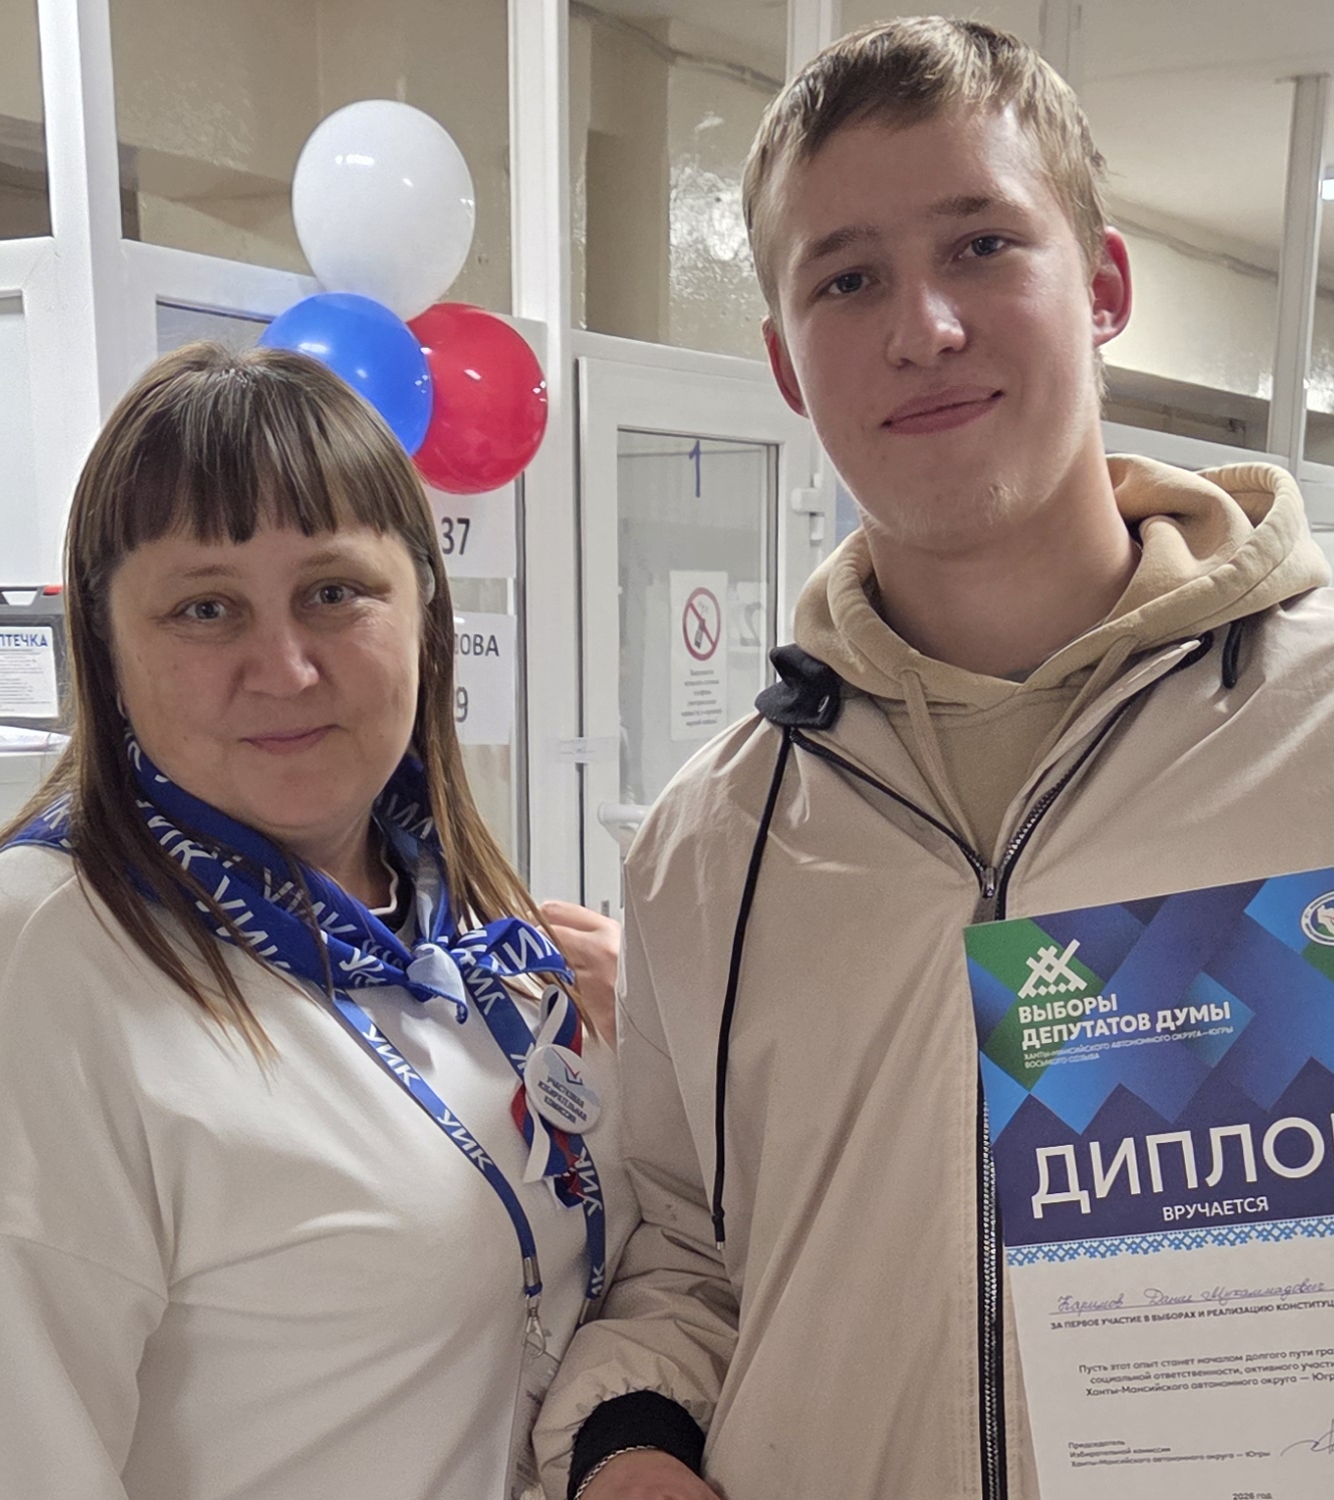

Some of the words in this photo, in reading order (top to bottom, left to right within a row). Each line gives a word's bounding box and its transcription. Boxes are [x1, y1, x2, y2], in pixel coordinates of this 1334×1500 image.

[1018, 993, 1117, 1024] ВЫБОРЫ
[1021, 1013, 1151, 1051] ДЕПУТАТОВ
[1155, 1001, 1232, 1033] ДУМЫ
[363, 1023, 421, 1087] УИК
[437, 1109, 493, 1170] УИК
[1162, 1196, 1269, 1222] ВРУЧАЕТСЯ
[1050, 1320, 1063, 1330] ЗА
[1064, 1318, 1099, 1328] ПЕРВОЕ
[1101, 1316, 1142, 1326] УЧАСТИЕ
[1144, 1314, 1150, 1322] В
[1152, 1312, 1196, 1322] ВЫБОРАХ
[1198, 1310, 1205, 1318] И
[1207, 1304, 1274, 1317] РЕАЛИЗАЦИЮ
[1079, 1364, 1108, 1375] Пусть
[1110, 1363, 1130, 1371] этот
[1133, 1361, 1158, 1369] опыт
[1161, 1358, 1195, 1367] станет
[1197, 1354, 1243, 1364] началом
[1245, 1351, 1287, 1362] долгого
[1289, 1349, 1313, 1360] пути
[1090, 1371, 1152, 1384] социальной
[1153, 1367, 1243, 1380] ответственности,
[1244, 1361, 1299, 1374] активного
[1086, 1382, 1189, 1397] Ханты-Мансийского
[1191, 1376, 1258, 1389] автономного
[1260, 1376, 1297, 1386] округа
